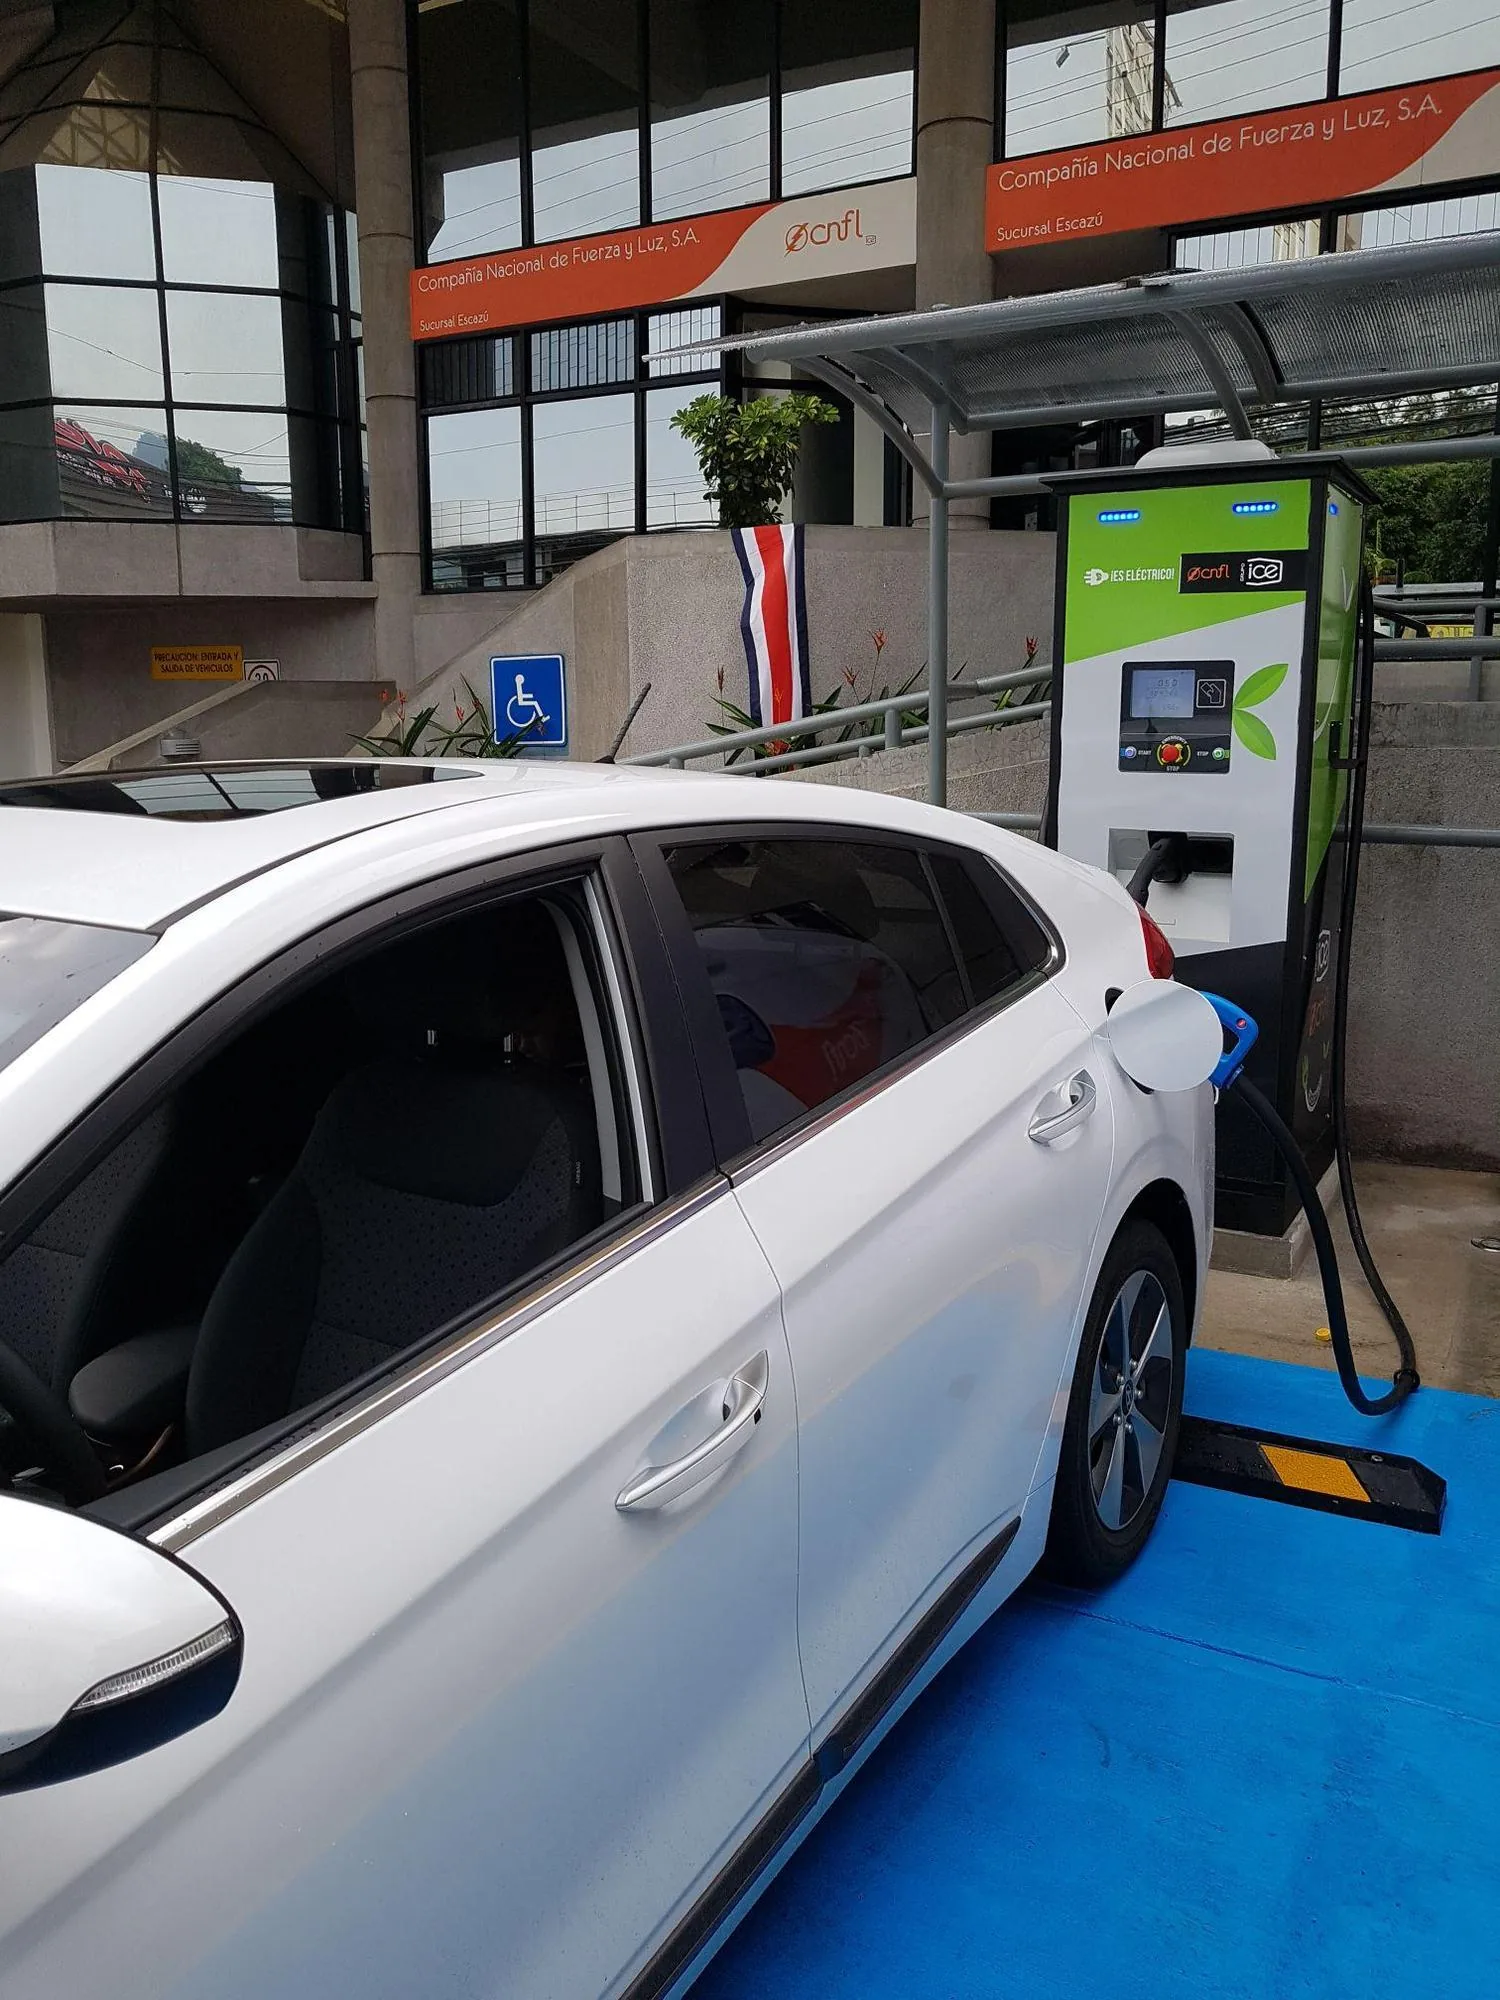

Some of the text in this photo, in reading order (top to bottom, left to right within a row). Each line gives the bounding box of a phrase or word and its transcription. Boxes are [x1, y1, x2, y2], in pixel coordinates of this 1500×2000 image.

[999, 93, 1443, 191] Compañía Nacional de Fuerza y Luz, S.A.
[997, 211, 1103, 242] Sucursal Escazú
[418, 227, 701, 292] Compañía Nacional de Fuerza y Luz, S.A.
[420, 310, 489, 332] Sucursal Escazú
[161, 664, 184, 673] SALIDA
[185, 664, 195, 673] DE
[200, 652, 232, 661] ENTRADA
[234, 652, 239, 660] Y
